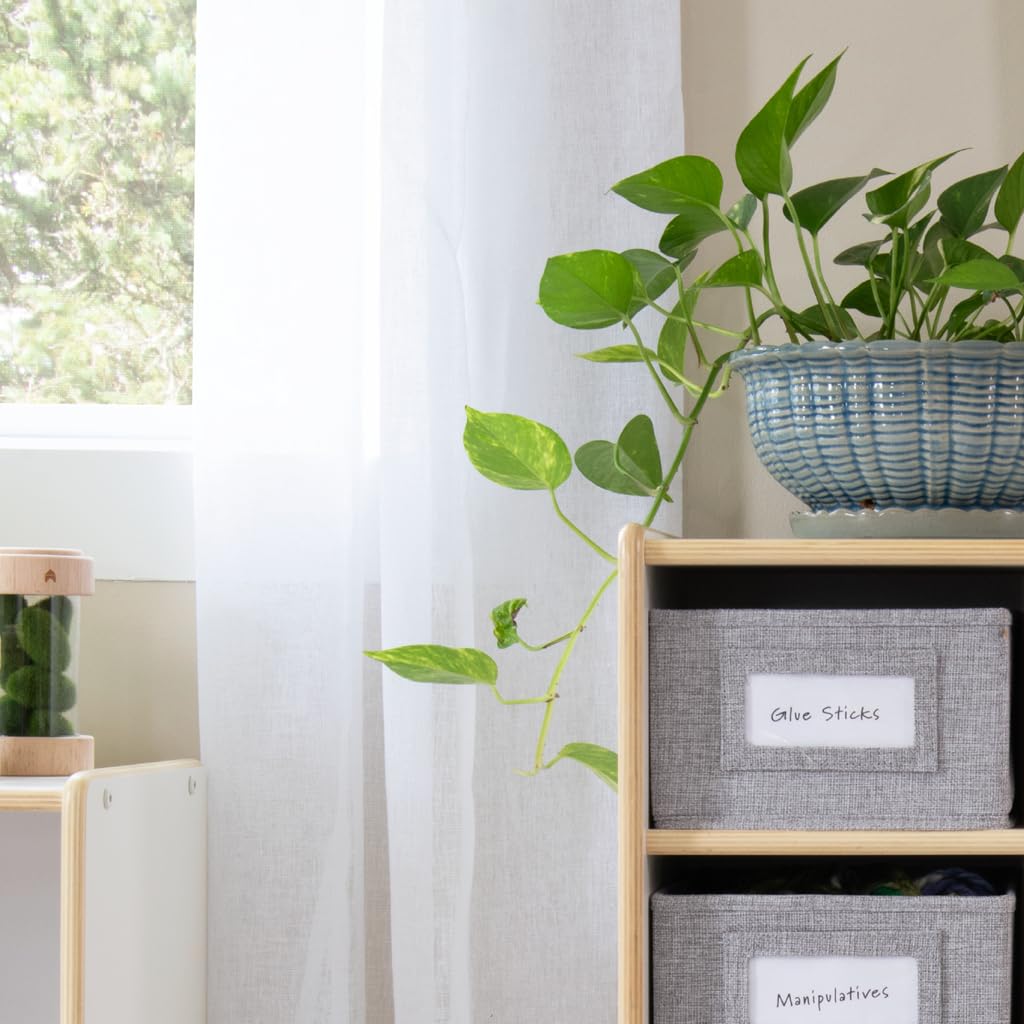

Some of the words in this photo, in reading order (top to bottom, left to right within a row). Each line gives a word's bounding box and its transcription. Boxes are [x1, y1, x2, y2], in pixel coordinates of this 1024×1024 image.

[770, 706, 813, 723] Glue
[821, 704, 881, 722] Sticks
[776, 985, 890, 1012] Manipulatives
